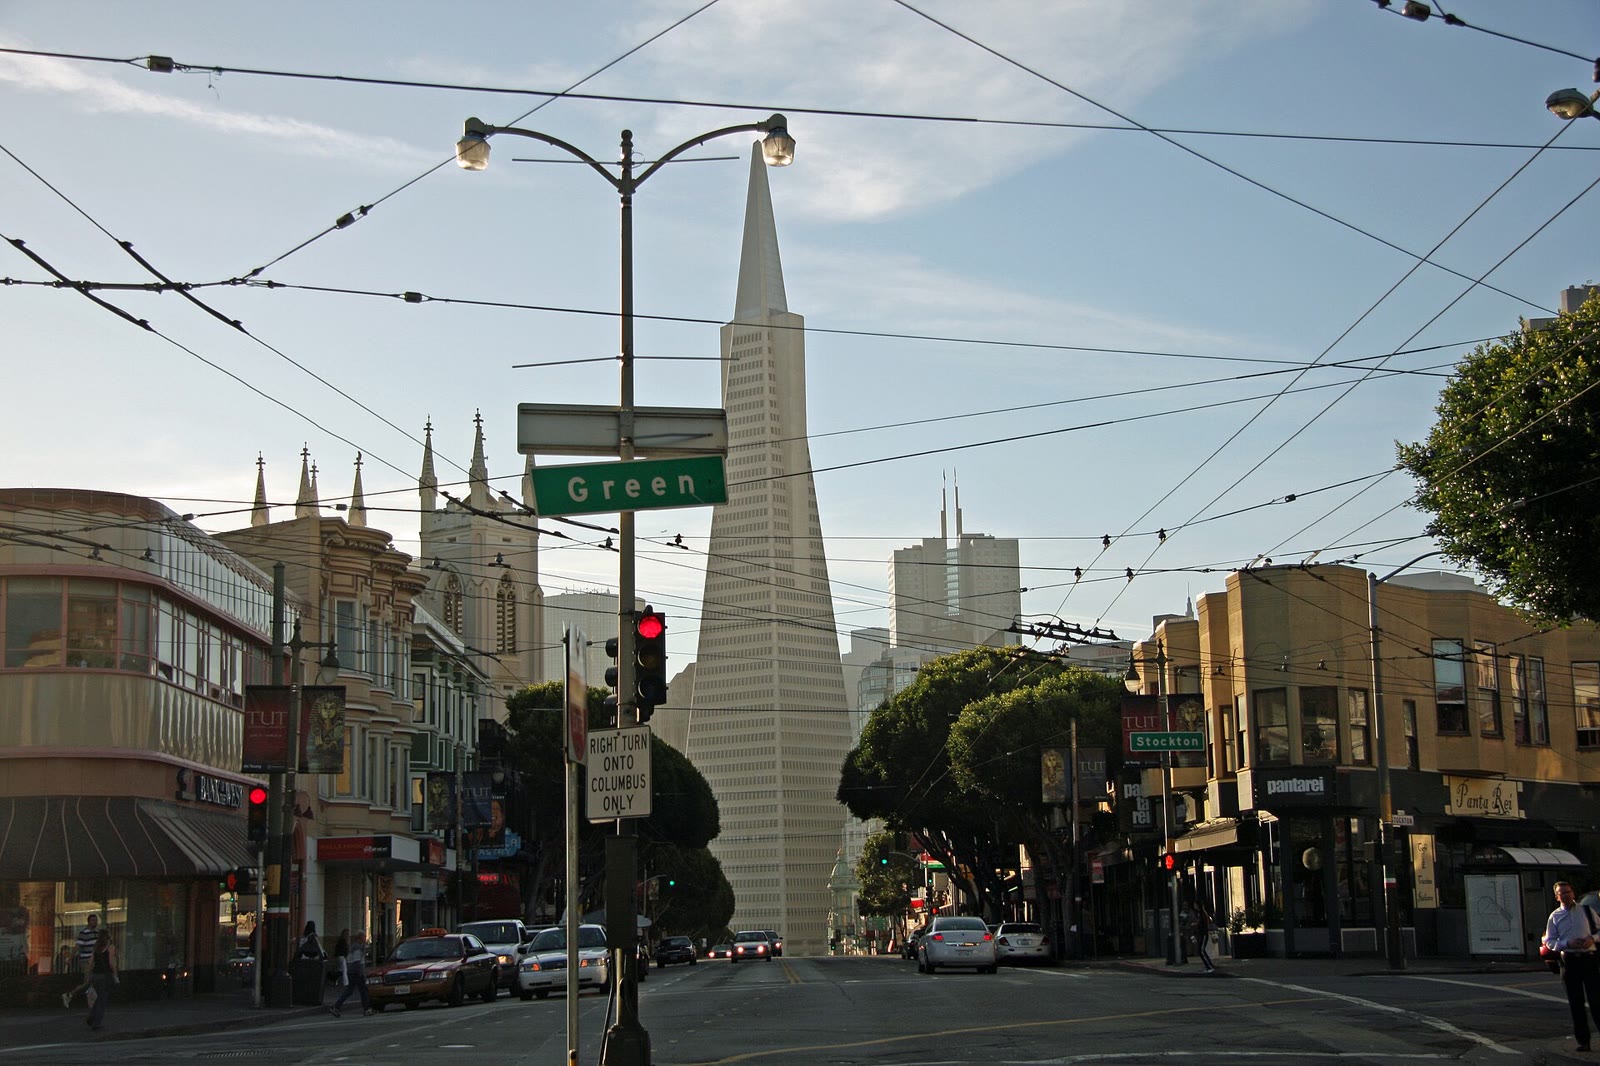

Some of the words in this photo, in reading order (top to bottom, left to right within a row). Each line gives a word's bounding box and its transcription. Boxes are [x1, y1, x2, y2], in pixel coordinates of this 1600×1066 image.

[567, 472, 696, 503] Green
[246, 711, 288, 725] TUT
[1122, 716, 1158, 728] TUT
[590, 736, 618, 754] RIGHT
[622, 733, 648, 751] TURN
[1136, 736, 1199, 747] Stockton
[603, 755, 634, 772] ONTO
[1078, 761, 1105, 771] TUT
[201, 775, 220, 803] BANK
[226, 782, 243, 808] WEST
[591, 774, 646, 792] COLUMBUS
[1123, 783, 1141, 799] pa
[1267, 777, 1324, 795] pantarei
[463, 787, 491, 797] TUT
[1456, 779, 1489, 809] Panta
[1492, 783, 1512, 815] Rei
[603, 794, 634, 811] ONLY
[1132, 811, 1150, 824] rei
